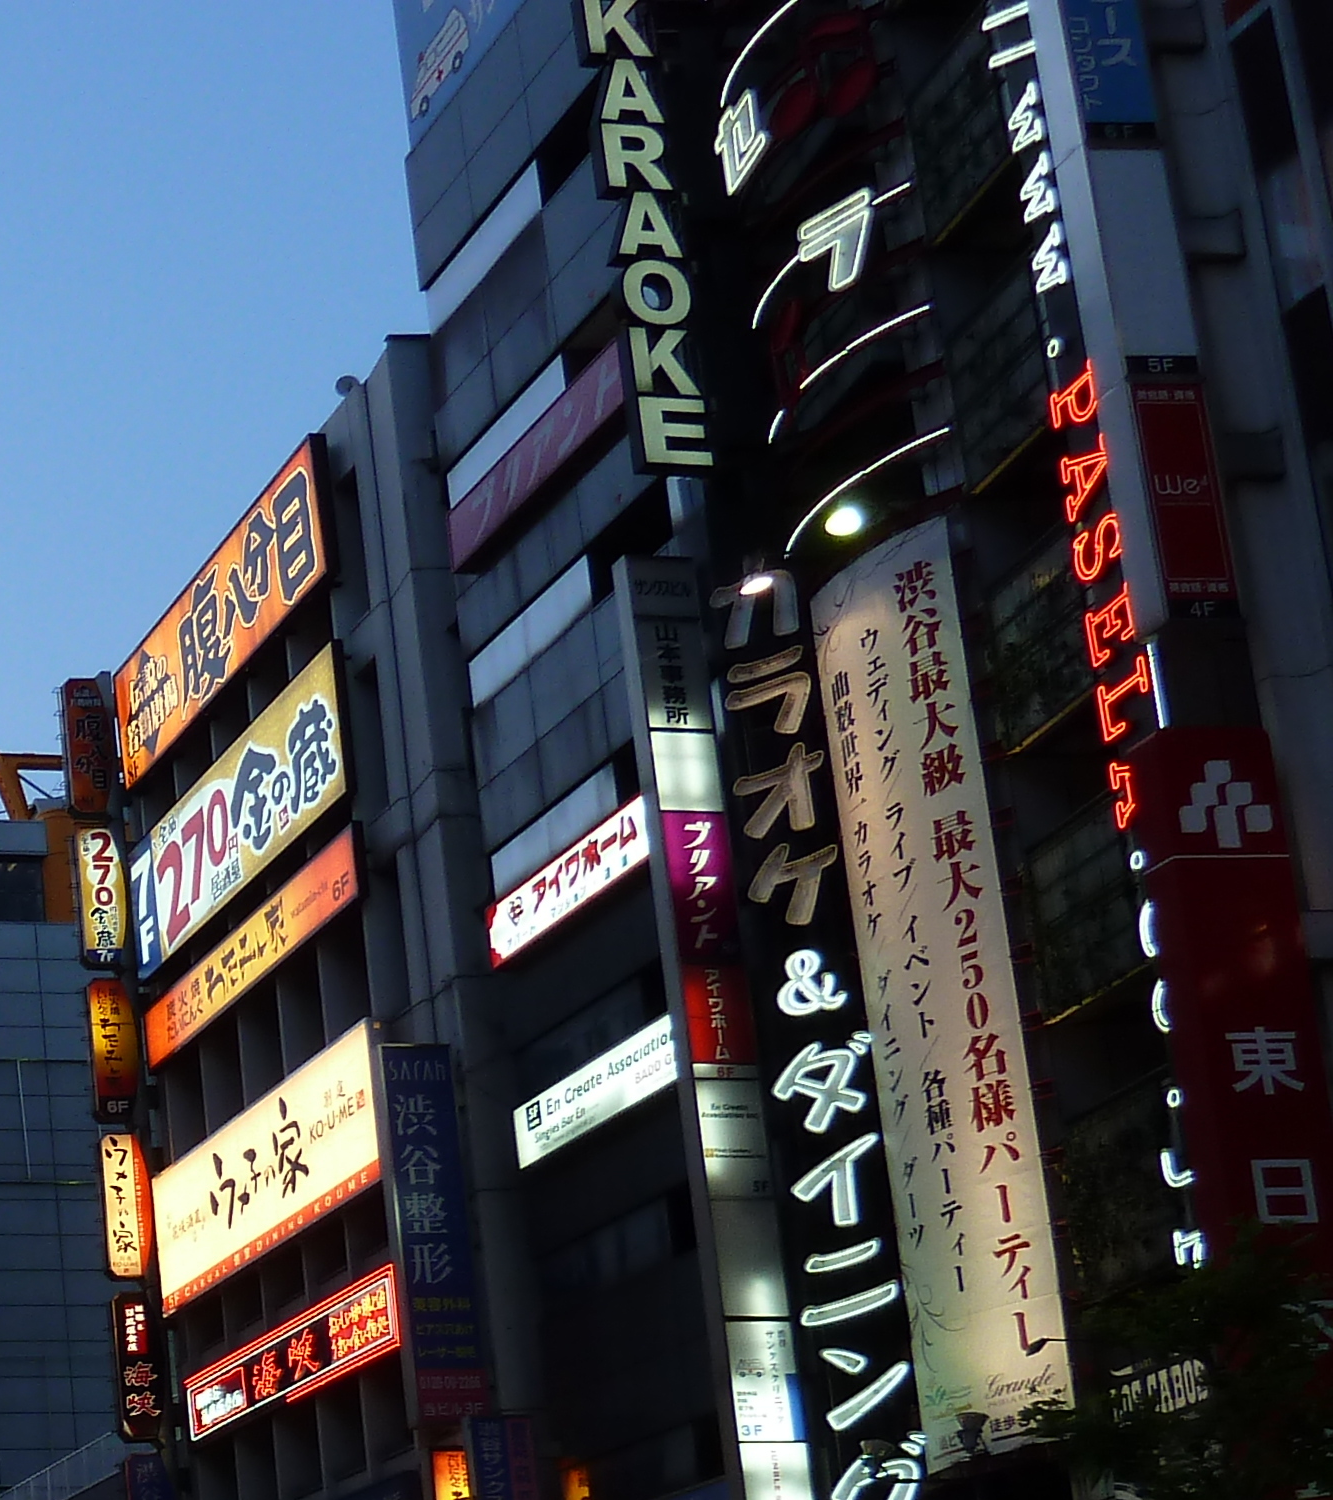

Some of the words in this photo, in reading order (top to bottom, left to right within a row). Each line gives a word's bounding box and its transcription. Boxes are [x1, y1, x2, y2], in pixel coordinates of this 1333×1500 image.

[580, 0, 715, 467] KARAOKE
[1147, 358, 1174, 373] 5F
[177, 465, 318, 721] 腹八分目
[1190, 601, 1215, 618] 4F
[654, 623, 690, 726] 山本事務所
[894, 560, 967, 798] 渋谷最大級
[231, 696, 338, 855] 金の蔵
[90, 831, 114, 907] 270
[130, 849, 155, 966] 7F
[157, 788, 229, 949] 270
[332, 870, 350, 902] 6F
[532, 815, 638, 915] アイワホーム
[683, 820, 719, 950] ブリアント
[96, 950, 115, 963] 7F
[704, 968, 730, 1061] アイワホーム
[106, 1100, 129, 1114] 6F
[546, 1098, 561, 1117] En
[564, 1073, 603, 1104] Create
[255, 1215, 304, 1252] DINING
[313, 1170, 368, 1214] KOUME
[393, 1093, 454, 1286] 渋谷整形
[123, 1360, 163, 1418] 海峡
[741, 1425, 763, 1436] 3F
